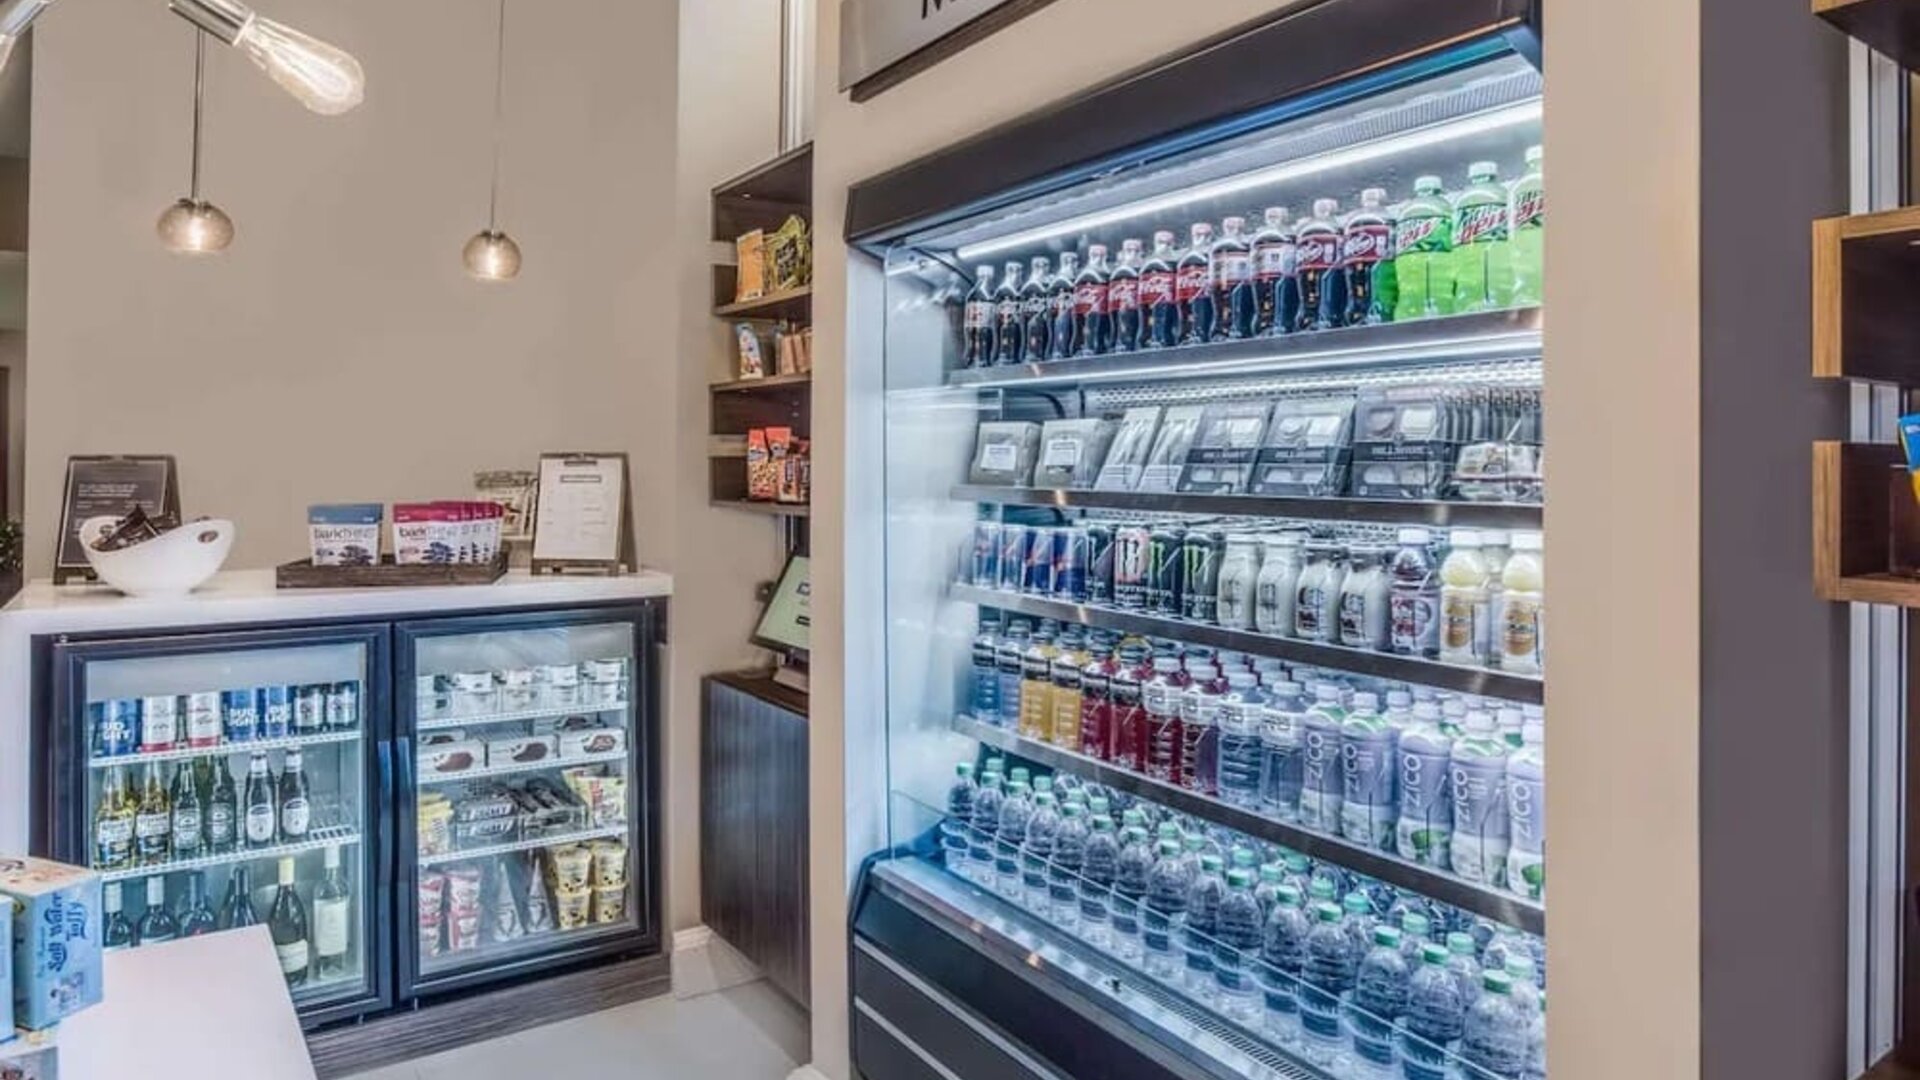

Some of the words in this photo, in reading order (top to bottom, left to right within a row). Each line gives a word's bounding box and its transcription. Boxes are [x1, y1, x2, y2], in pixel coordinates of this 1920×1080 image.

[1305, 731, 1323, 780] ZICO
[1344, 743, 1360, 792] ZICO
[1402, 754, 1422, 807] ZICO
[1453, 768, 1470, 823] ZICO
[1512, 782, 1532, 840] ZICO
